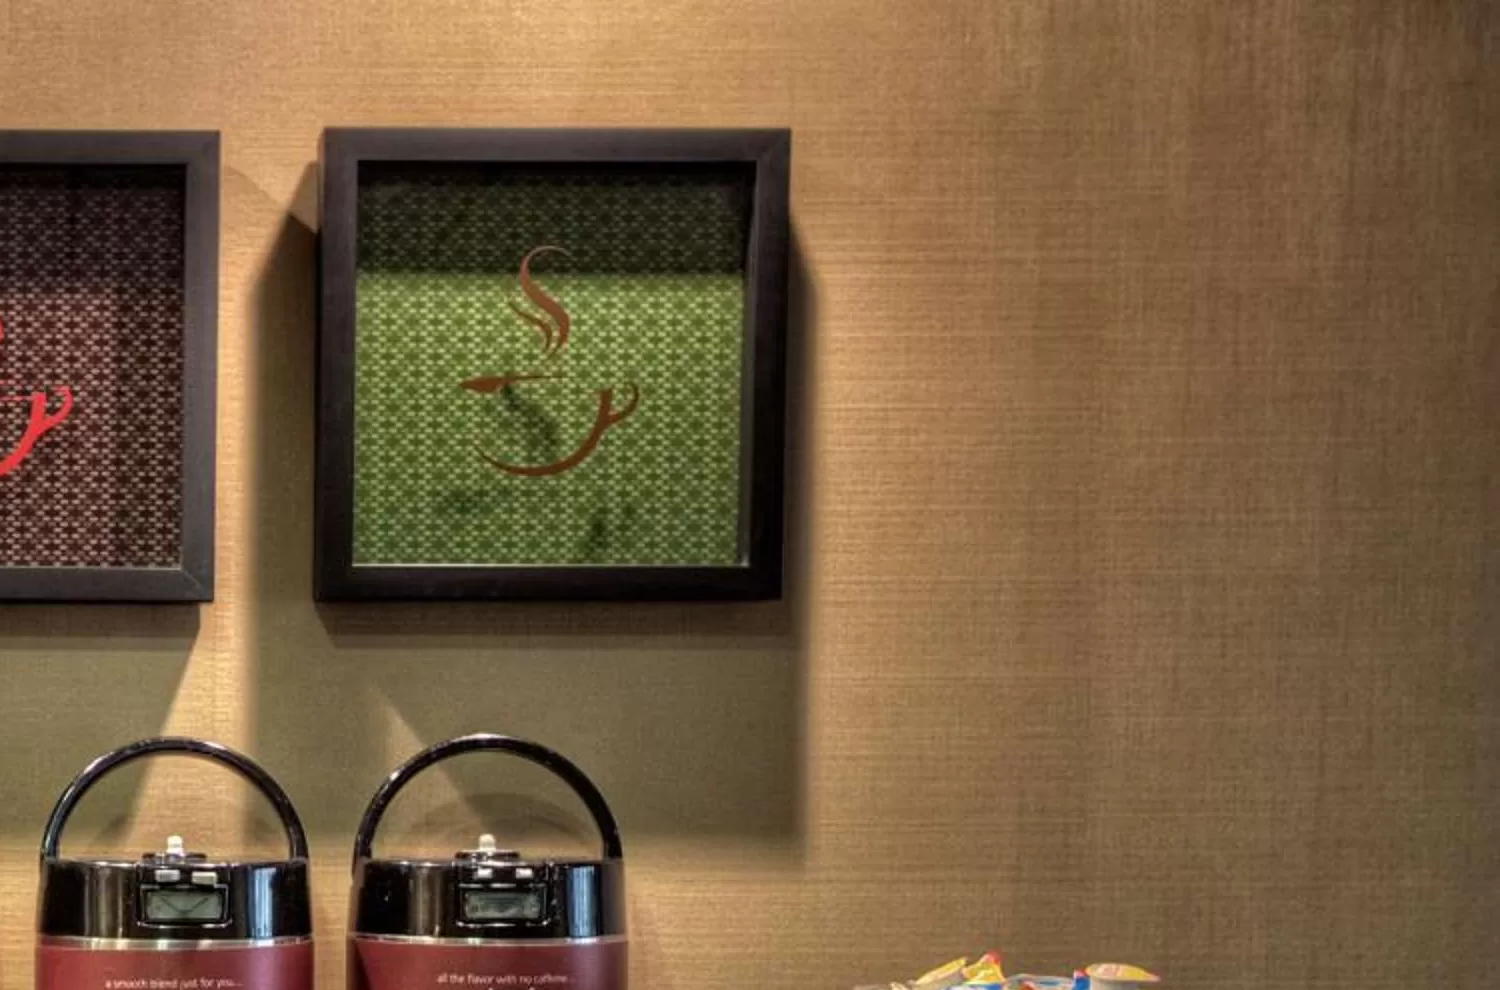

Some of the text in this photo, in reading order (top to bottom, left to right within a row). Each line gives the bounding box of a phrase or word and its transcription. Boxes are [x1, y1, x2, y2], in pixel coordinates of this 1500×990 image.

[104, 980, 113, 989] a
[200, 976, 215, 988] for
[450, 973, 465, 984] the
[467, 972, 494, 985] flavor
[495, 973, 518, 985] with
